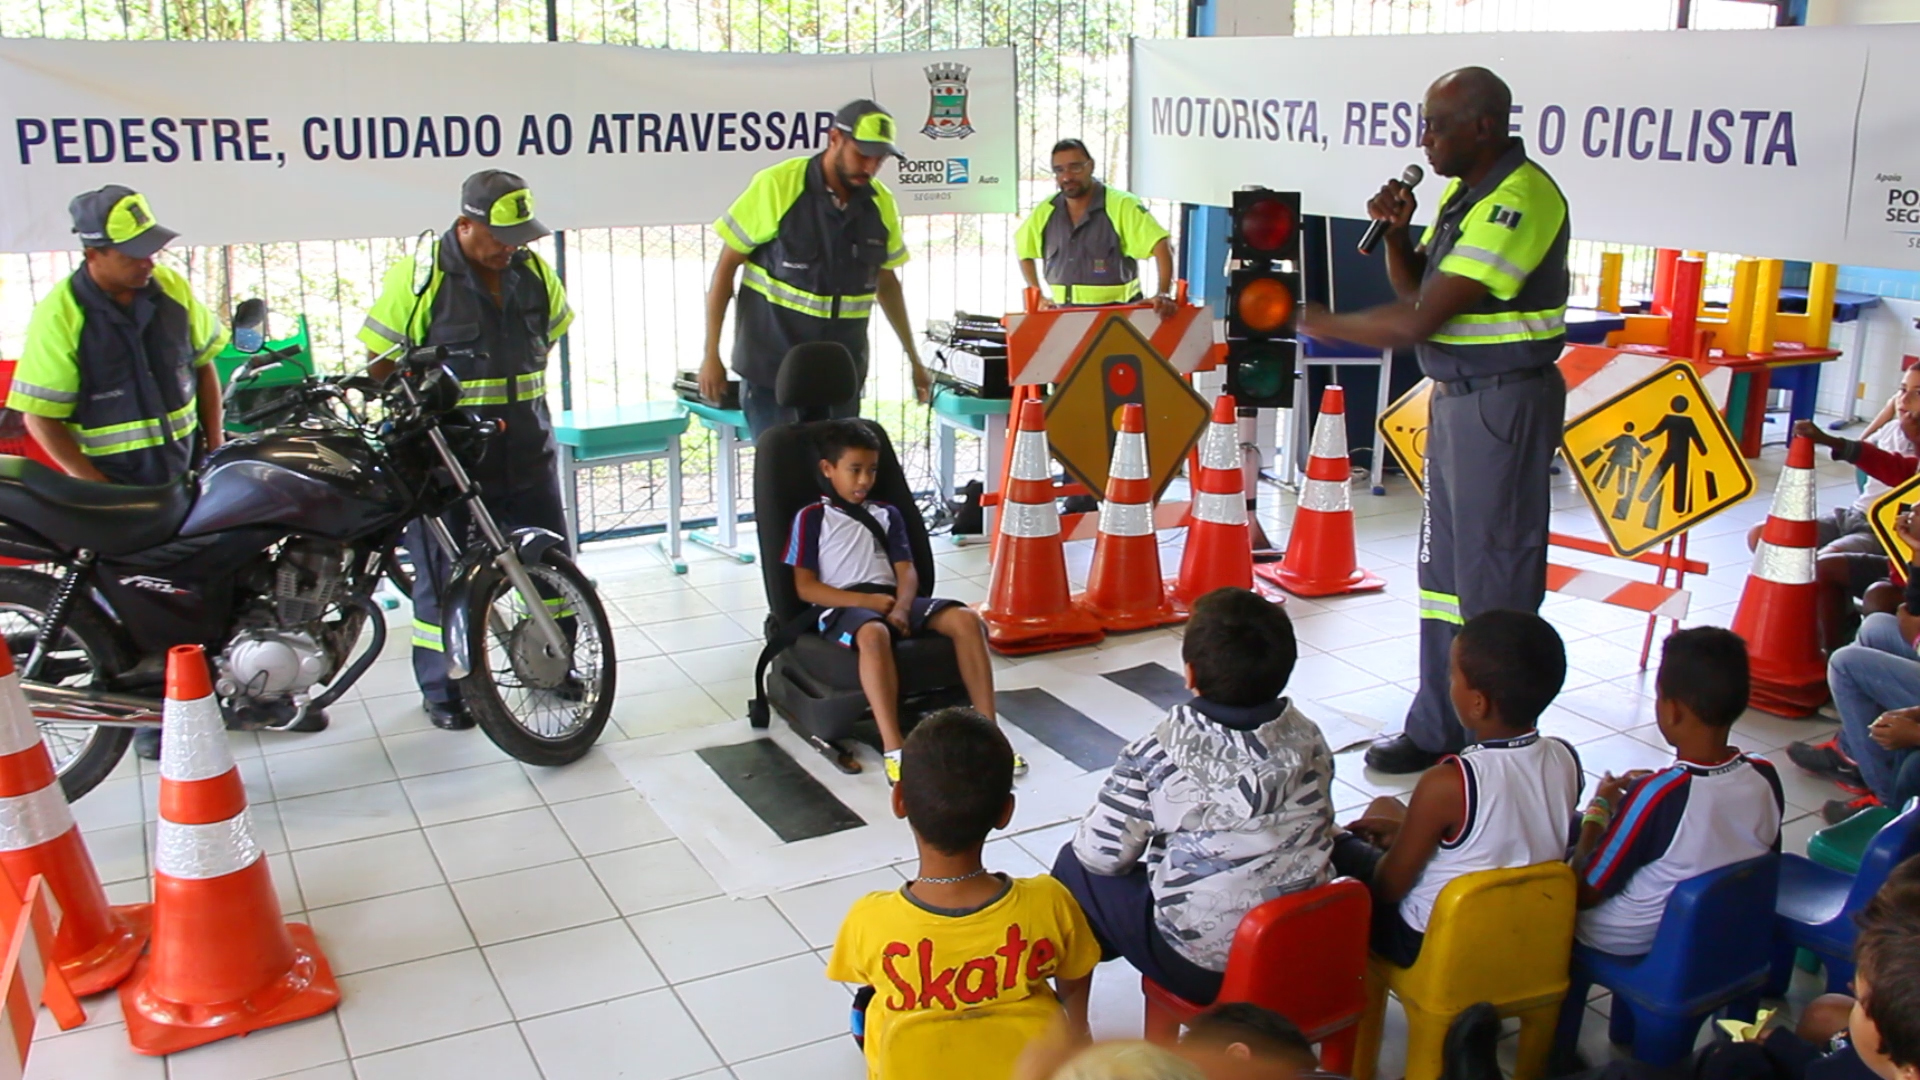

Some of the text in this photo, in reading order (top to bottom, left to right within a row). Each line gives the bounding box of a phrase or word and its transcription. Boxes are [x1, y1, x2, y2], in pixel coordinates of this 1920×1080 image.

[16, 111, 837, 168] PEDESTRE, CUIDADO AO ATRAVESSAR
[1151, 96, 1328, 151] MOTORISTA,
[1538, 105, 1566, 155] O
[1582, 106, 1798, 166] CICLISTA
[898, 160, 944, 172] PORTO
[898, 173, 943, 184] SEGURO
[978, 176, 1000, 184] Auto
[1888, 189, 1920, 206] PO
[882, 923, 1056, 1011] Skate
